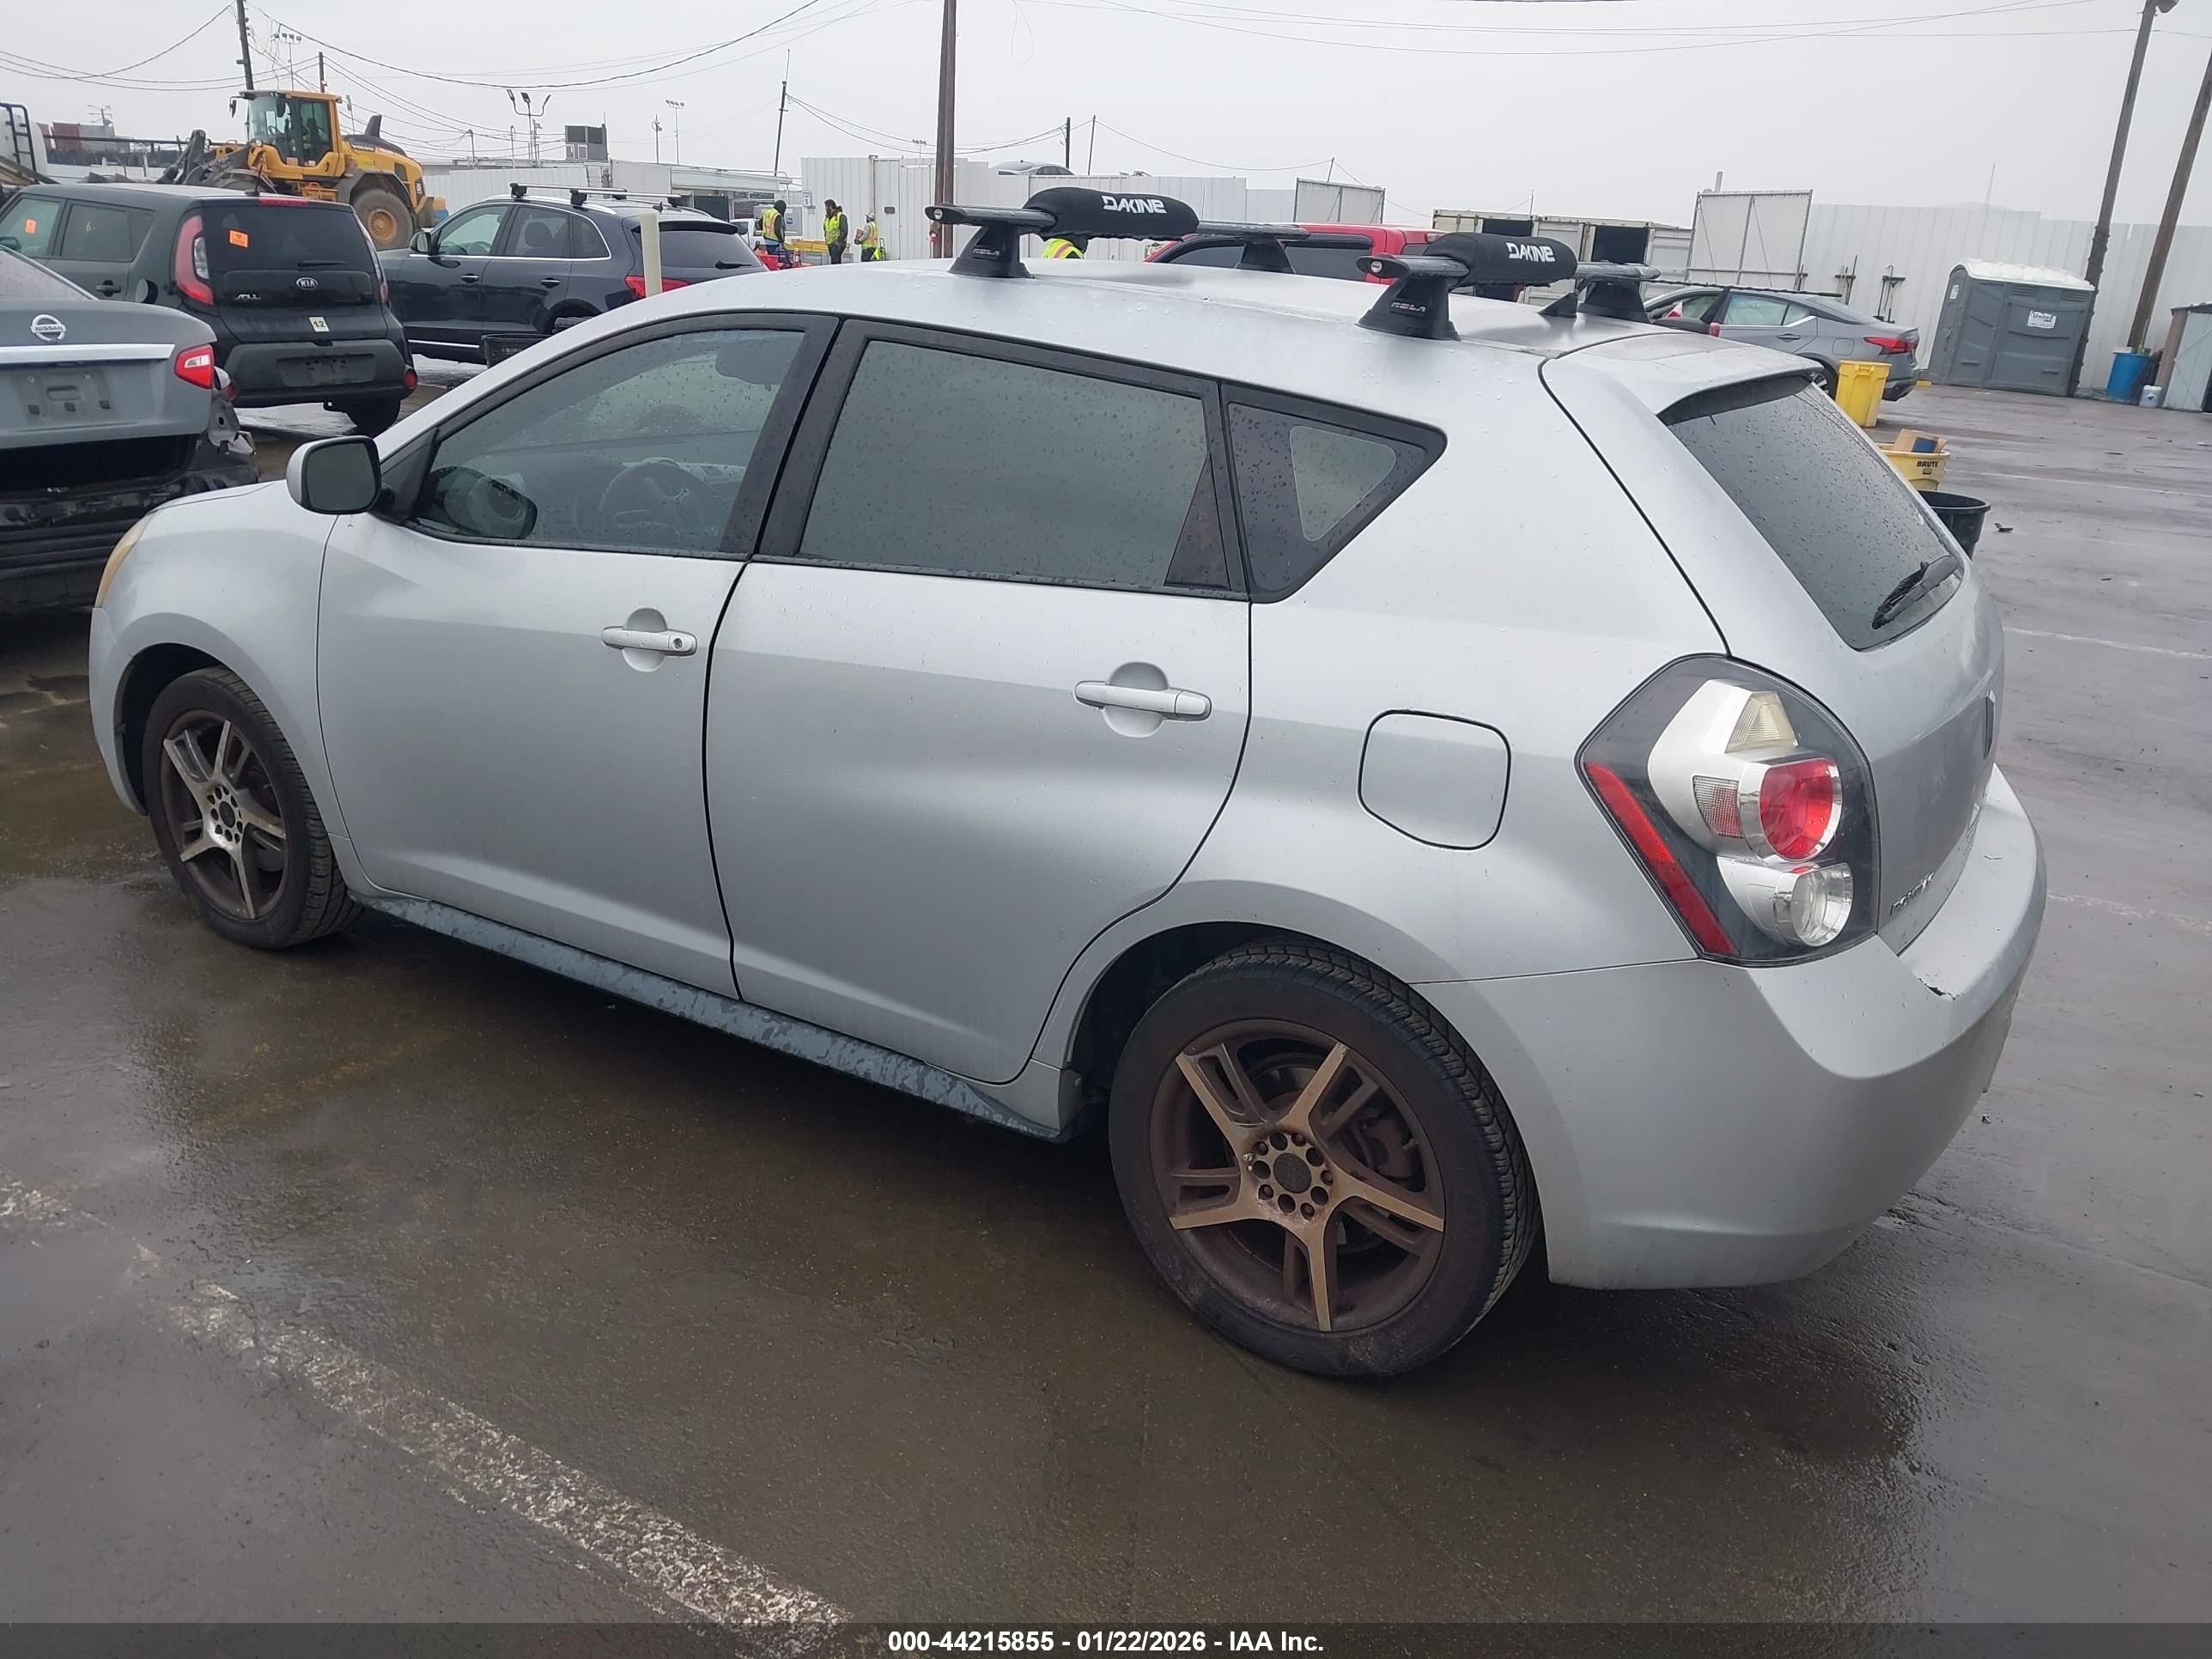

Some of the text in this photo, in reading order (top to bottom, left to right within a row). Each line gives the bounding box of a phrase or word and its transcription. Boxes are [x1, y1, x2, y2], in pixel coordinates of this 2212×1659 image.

[1101, 195, 1168, 214] DAKINE
[1505, 242, 1556, 262] DAKINE
[299, 279, 316, 288] KIA
